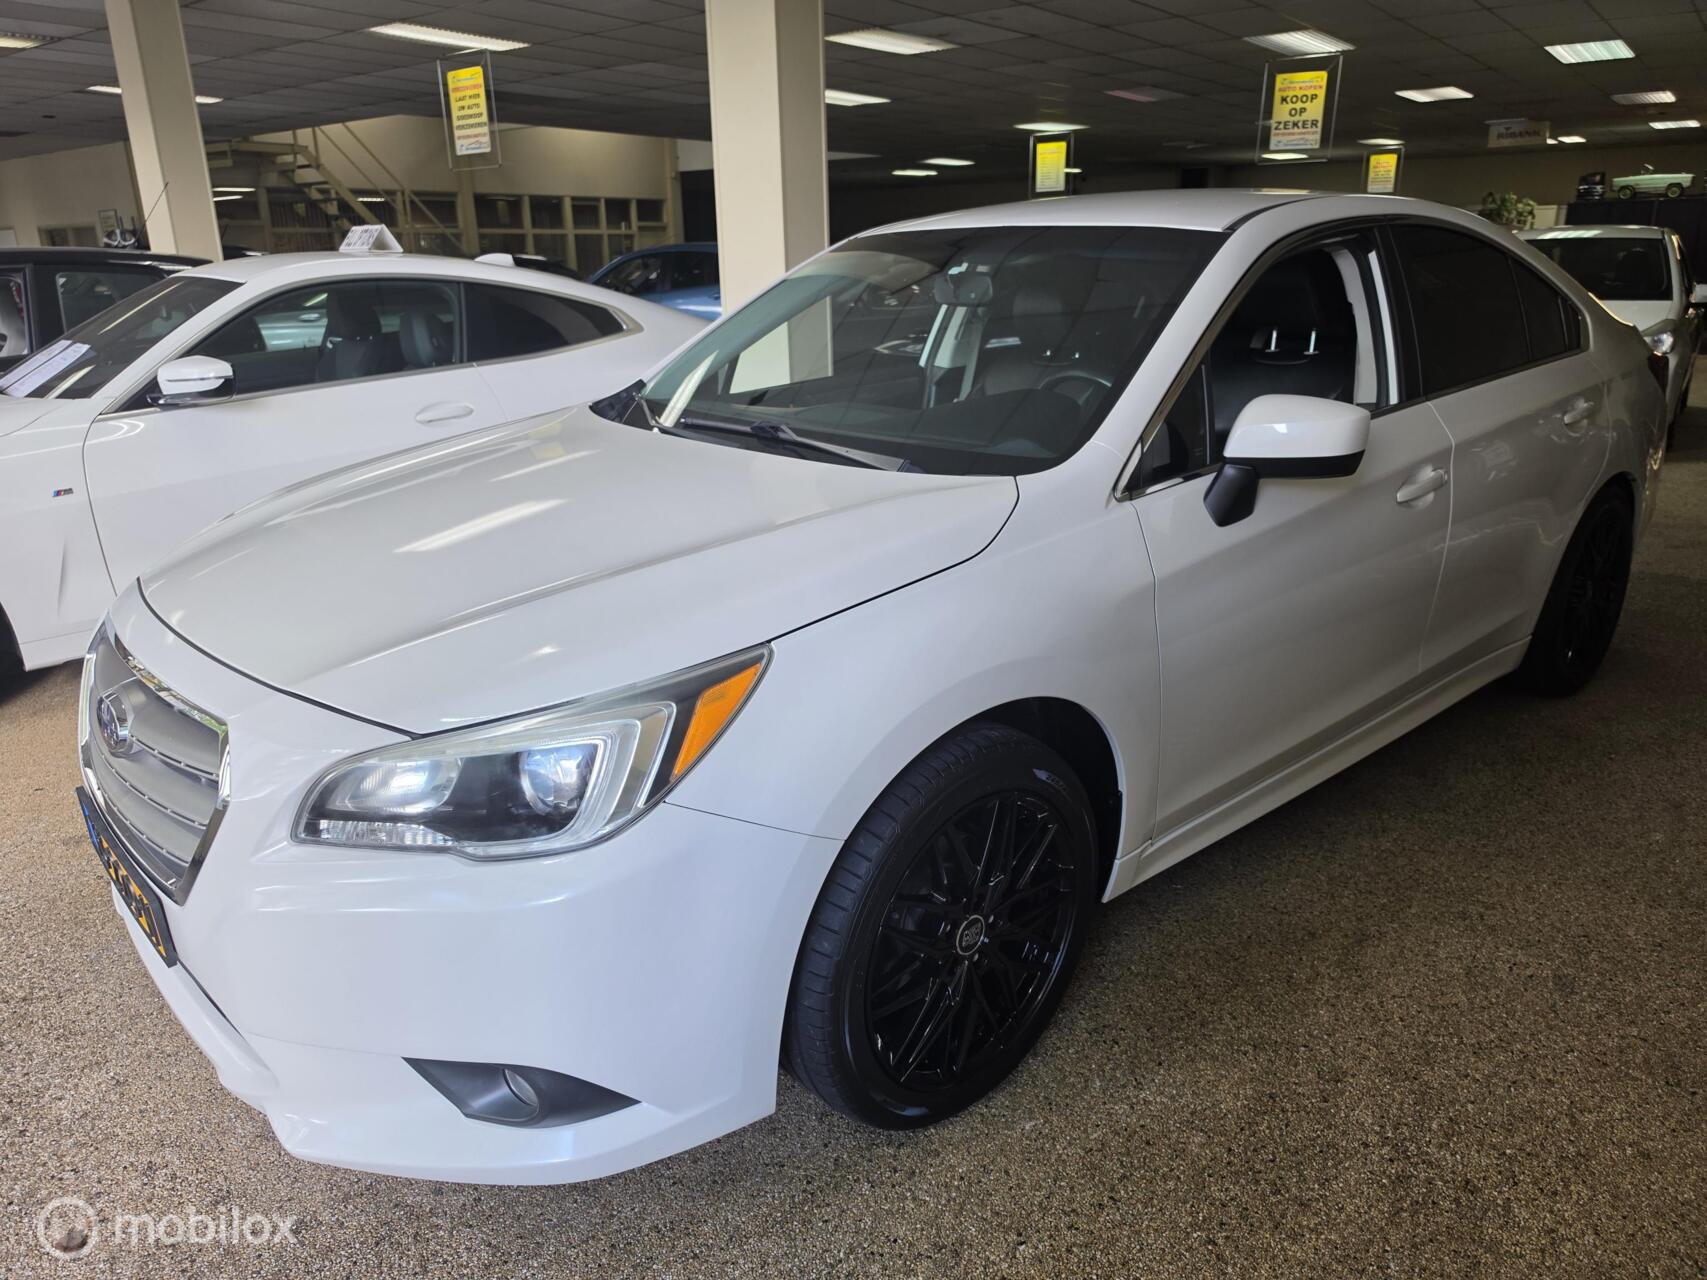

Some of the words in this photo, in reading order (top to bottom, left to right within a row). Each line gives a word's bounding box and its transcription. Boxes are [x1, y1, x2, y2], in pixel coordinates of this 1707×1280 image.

[1280, 94, 1318, 105] KOOP
[1288, 107, 1307, 117] OP
[1274, 119, 1319, 130] ZEKER
